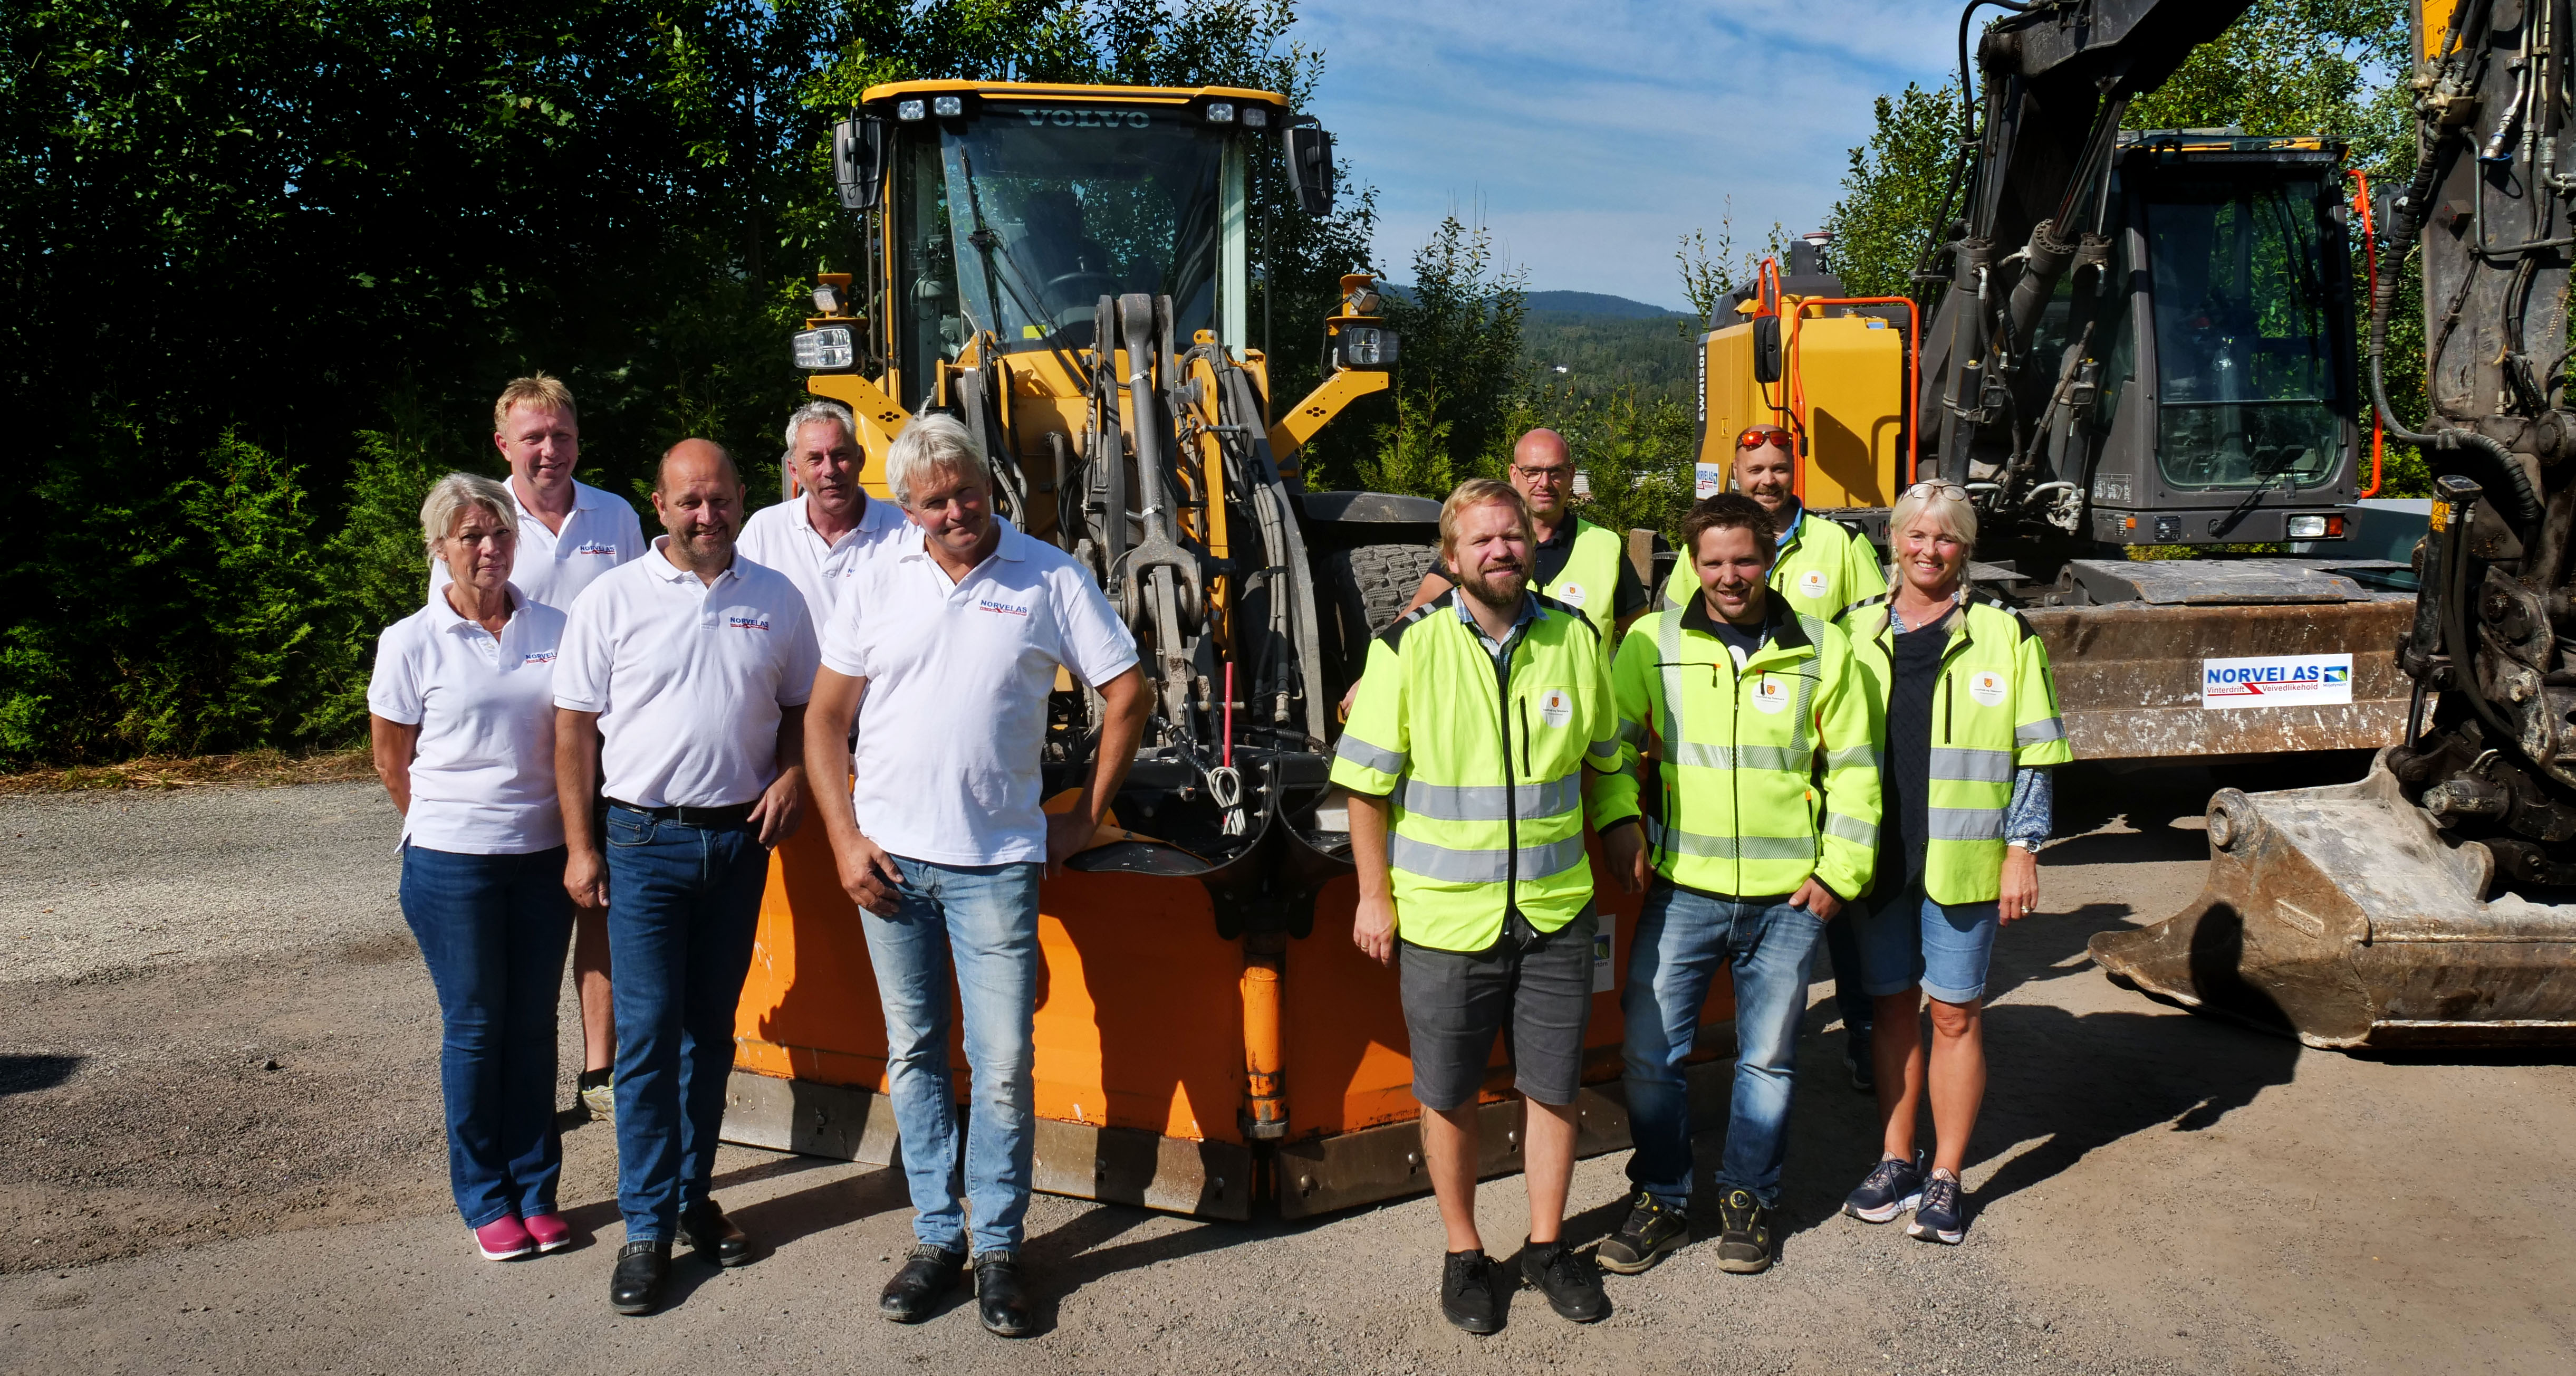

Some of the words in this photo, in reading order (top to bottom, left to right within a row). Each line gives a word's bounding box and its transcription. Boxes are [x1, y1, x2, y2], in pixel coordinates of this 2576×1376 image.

[1018, 109, 1150, 128] VOLVO
[981, 600, 1013, 611] NORVEI
[730, 617, 757, 625] NORVEI
[2207, 666, 2285, 683] NORVEI
[2292, 665, 2319, 680] AS
[2262, 683, 2318, 692] Veivedlikehold
